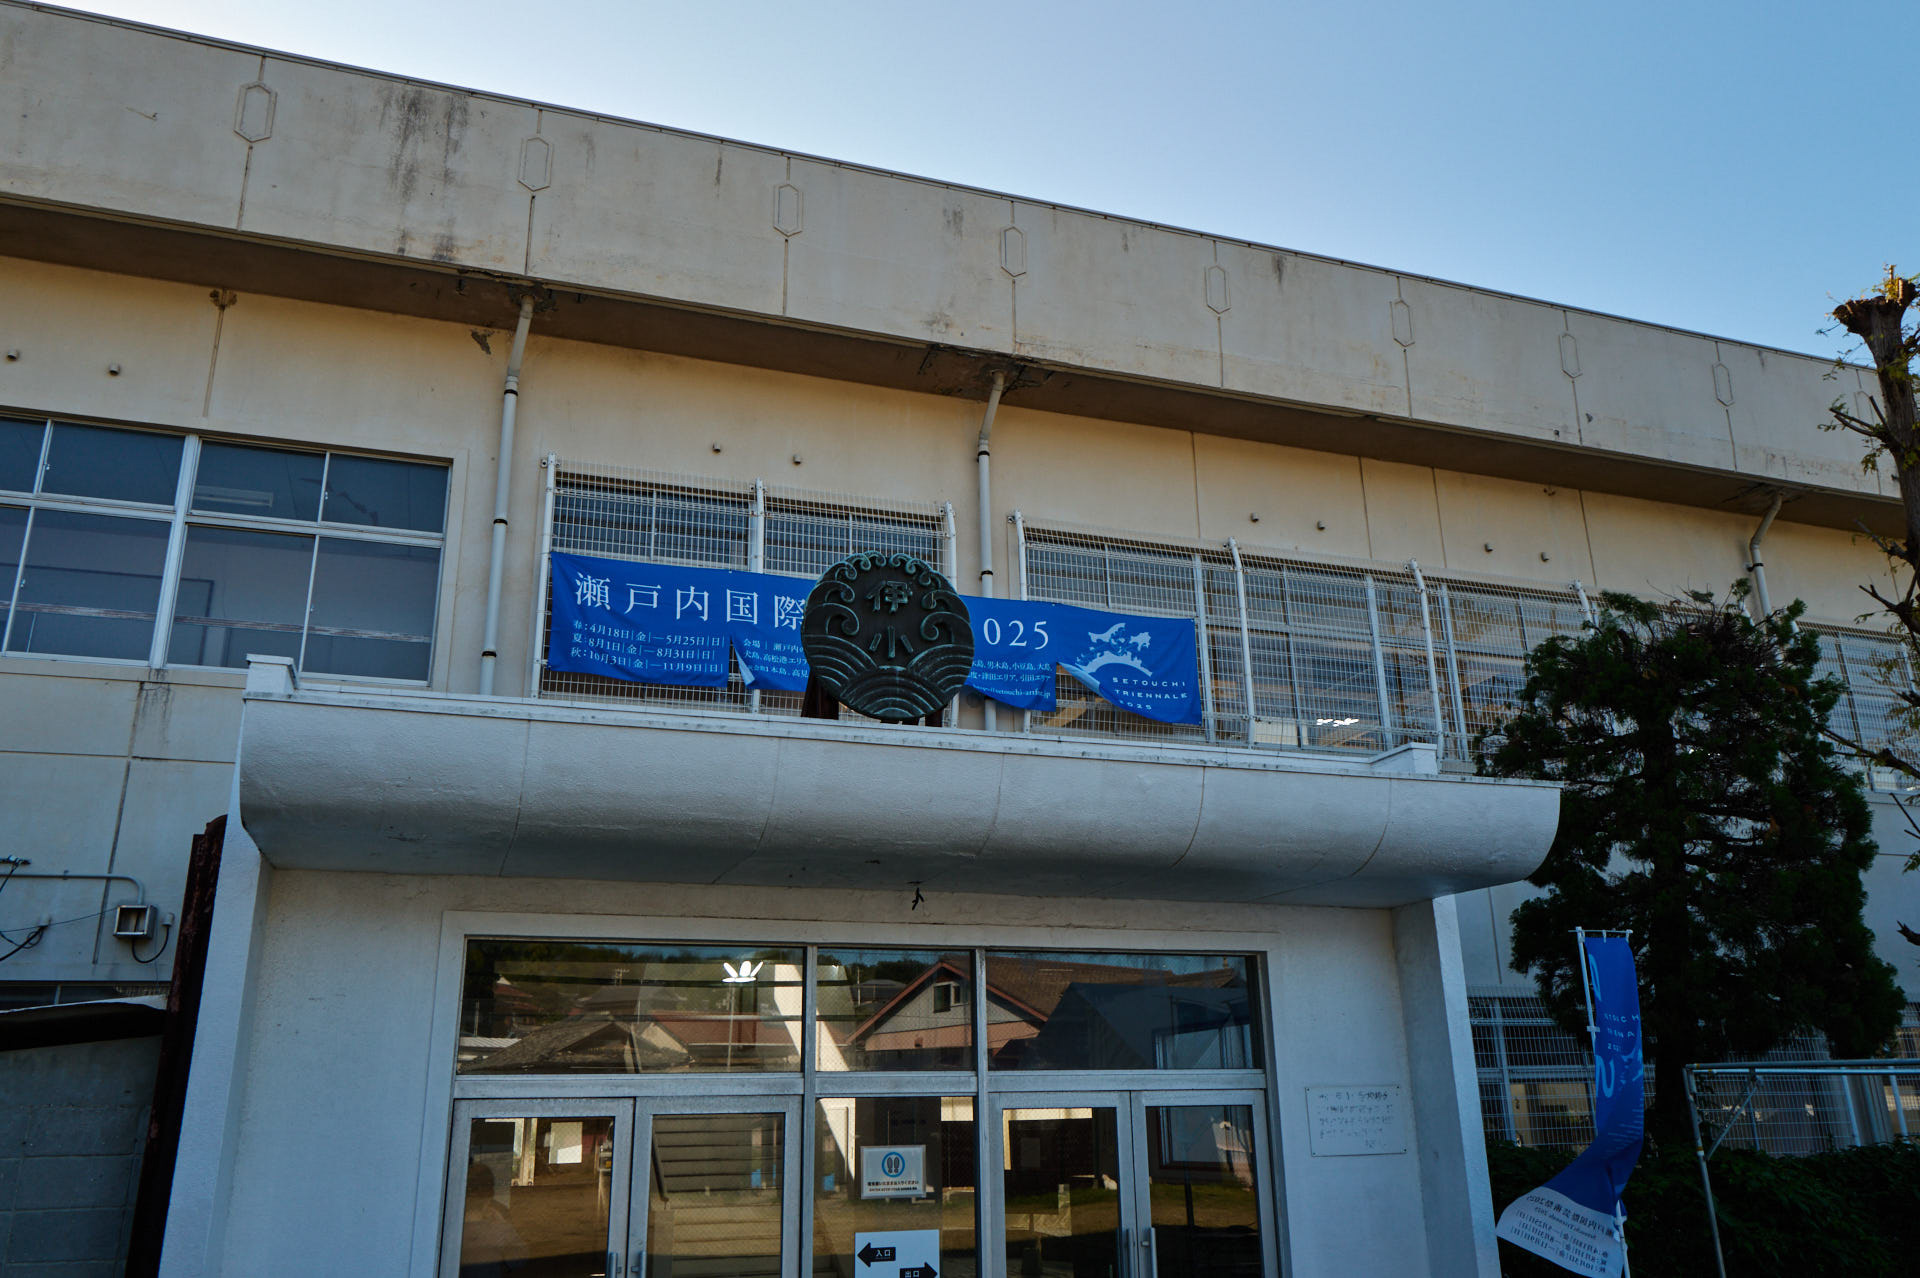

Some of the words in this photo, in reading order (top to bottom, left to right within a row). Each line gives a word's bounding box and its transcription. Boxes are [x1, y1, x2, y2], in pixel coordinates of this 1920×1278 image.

[575, 572, 806, 630] 瀬戸内国際
[983, 618, 1049, 650] 025
[1112, 677, 1186, 687] SETOUCHI
[1114, 689, 1188, 699] TRIENNALE
[875, 1249, 891, 1257] 入口
